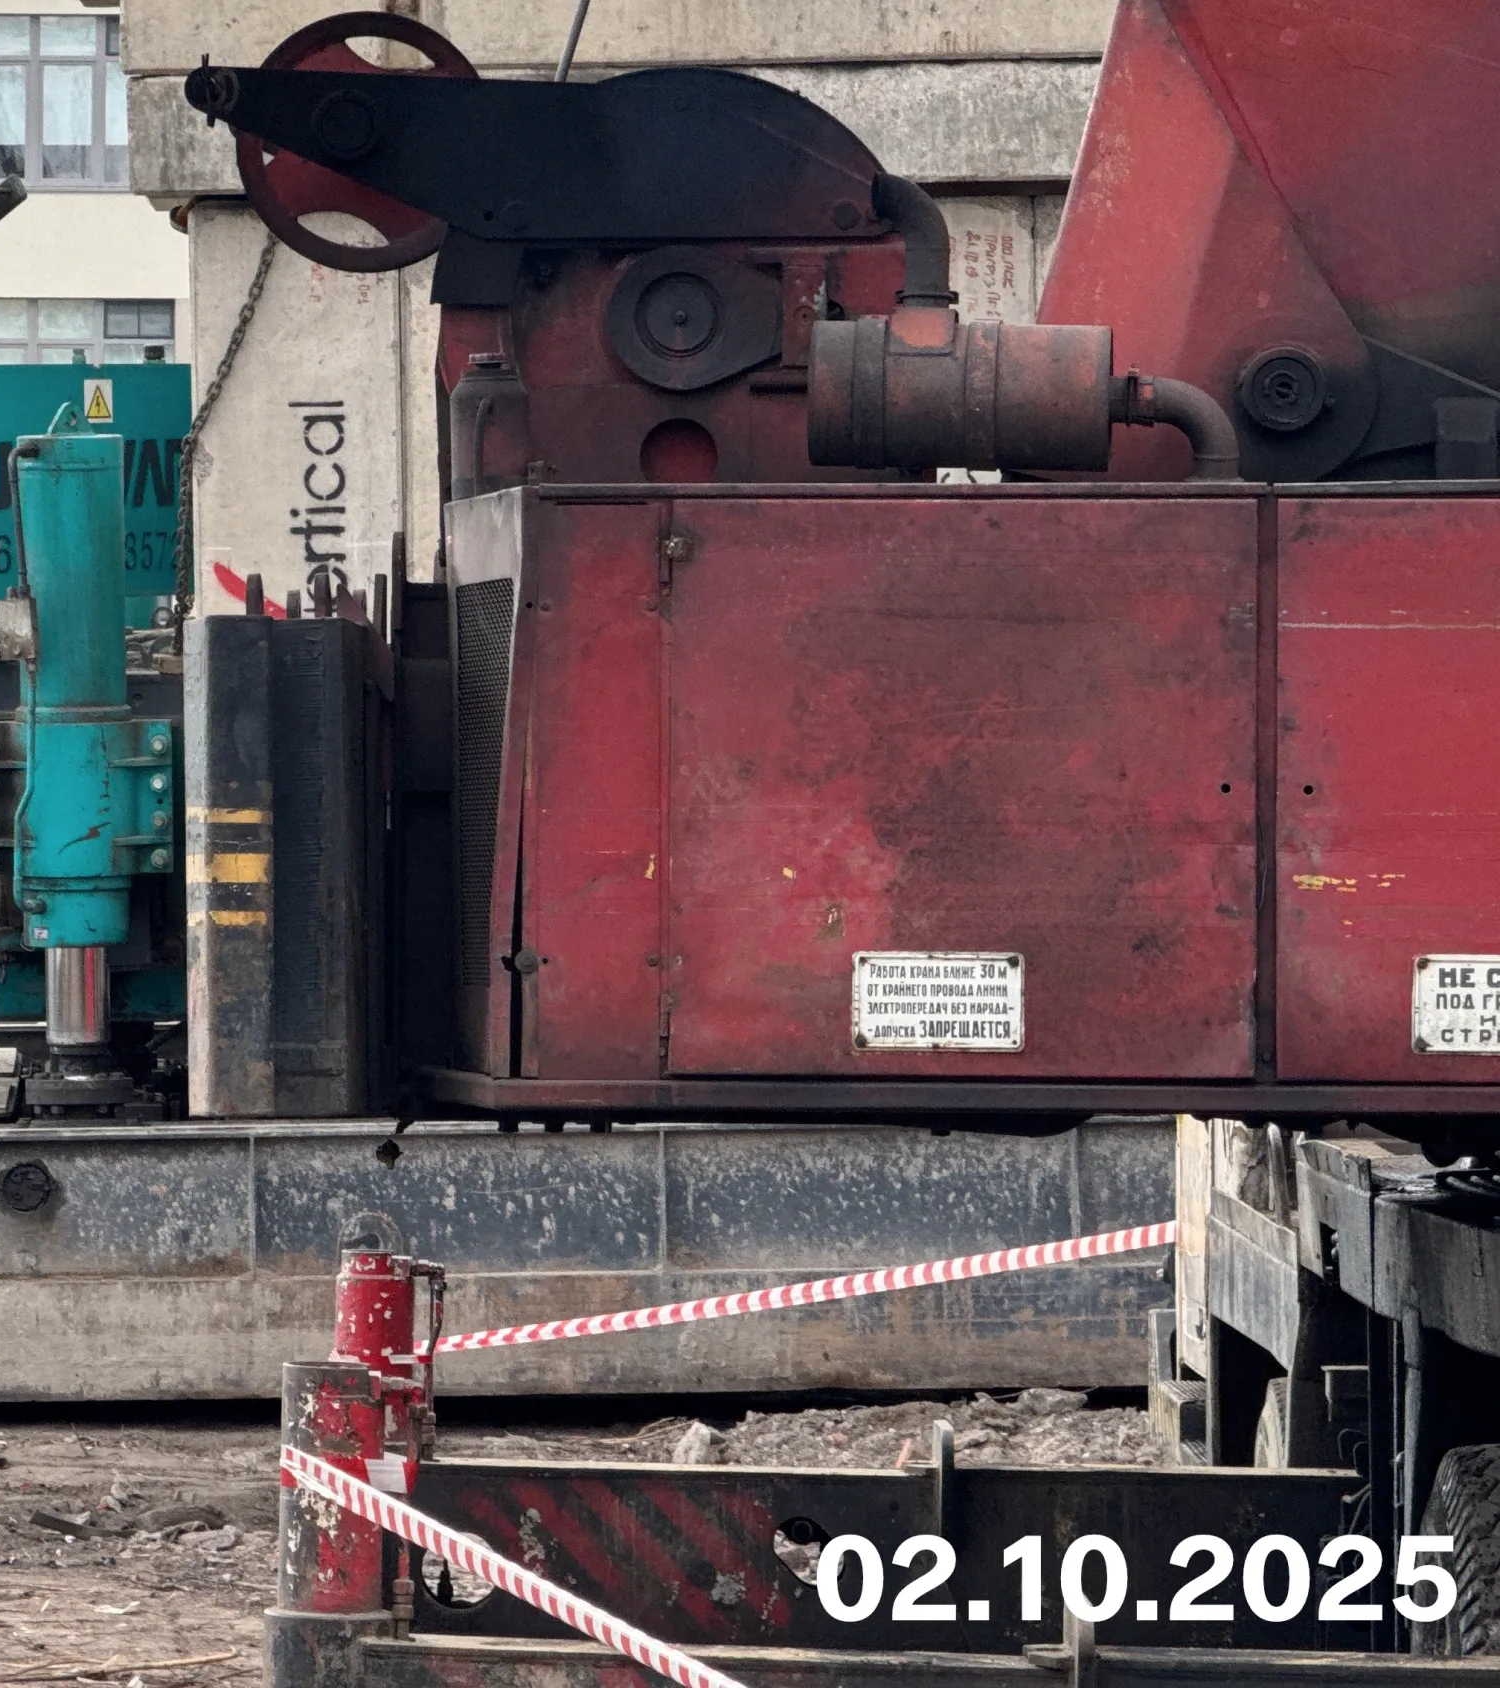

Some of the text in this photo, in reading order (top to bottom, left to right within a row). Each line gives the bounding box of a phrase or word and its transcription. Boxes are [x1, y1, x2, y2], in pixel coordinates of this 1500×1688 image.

[287, 400, 347, 613] ertical
[869, 963, 906, 979] РАБОТА
[909, 965, 941, 979] КРАНА
[943, 965, 976, 979] БЛИЖЕ
[980, 963, 995, 979] 30
[1438, 967, 1476, 988] НЕ
[867, 980, 1008, 997] ОТ КРАЙНЕГО ПРОВОДА ЛИНИИ
[867, 1001, 948, 1015] ЭЛЕКТРОПЕРЕДАЧ
[951, 1002, 967, 1015] БЕЗ
[1436, 993, 1475, 1010] ПОД
[919, 1020, 1011, 1039] ЗАПРЕЩАЕТСЯ
